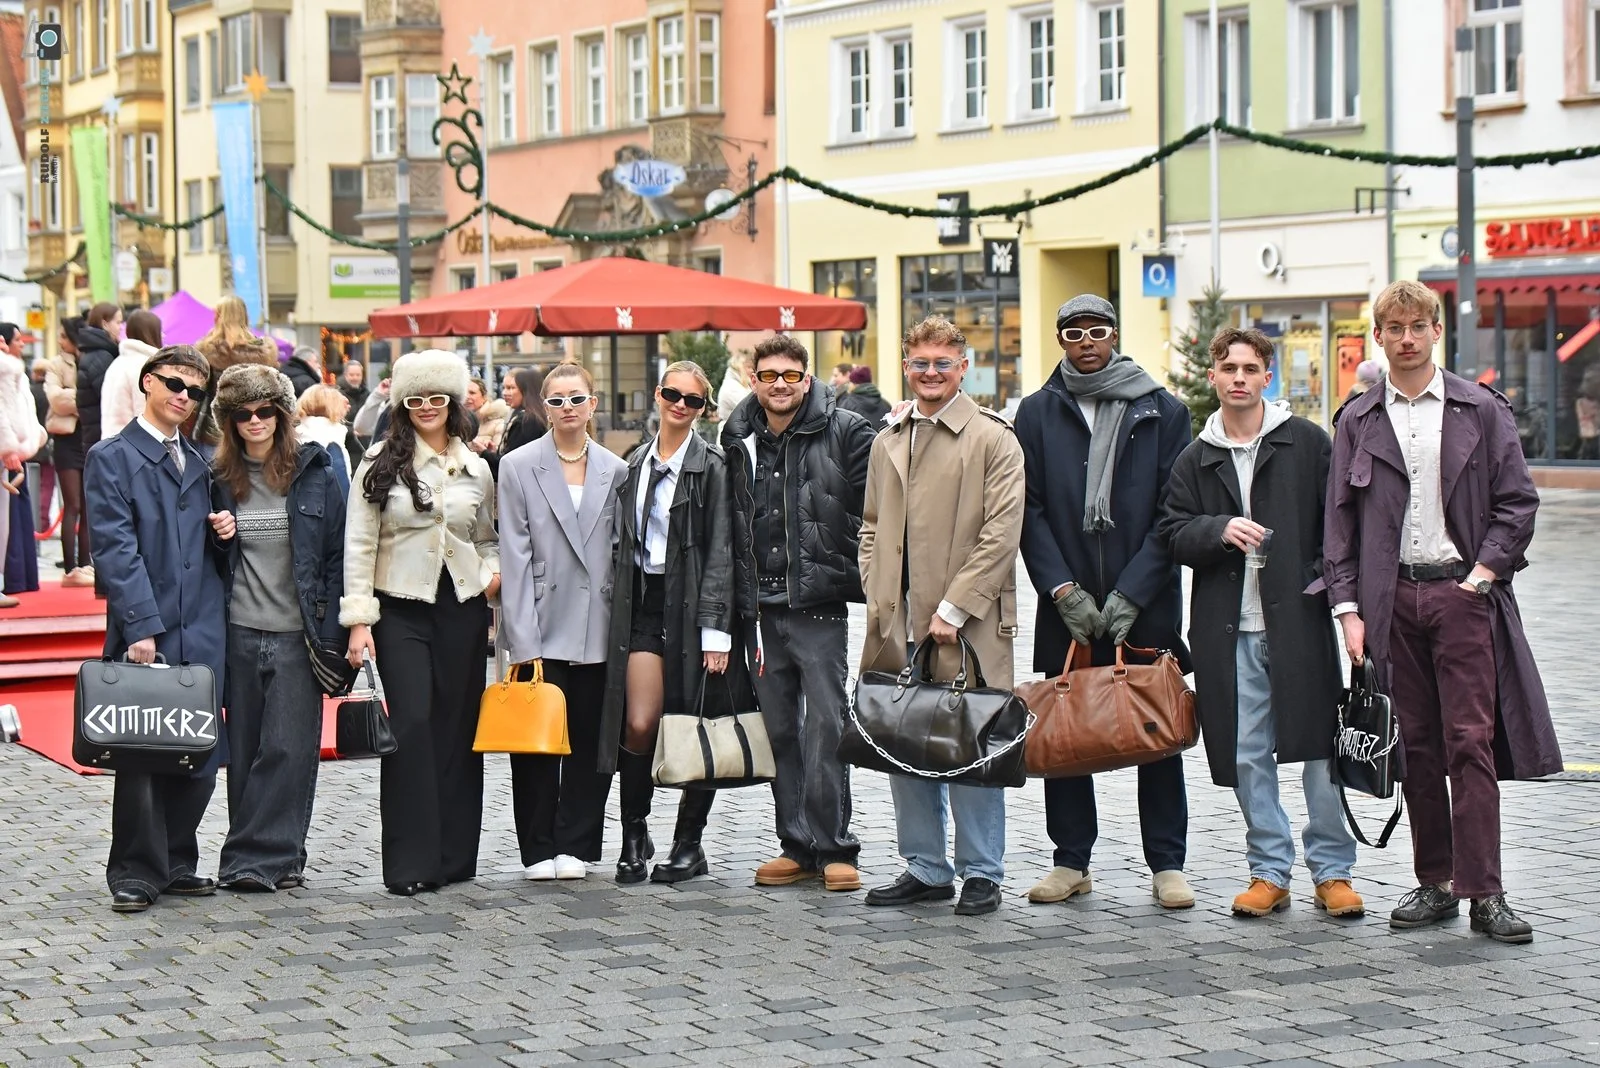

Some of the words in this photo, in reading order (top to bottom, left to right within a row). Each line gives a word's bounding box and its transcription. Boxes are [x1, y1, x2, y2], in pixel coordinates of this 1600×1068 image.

[631, 161, 670, 186] Oskar
[991, 241, 1013, 275] WMF
[84, 704, 216, 740] COMMERZ
